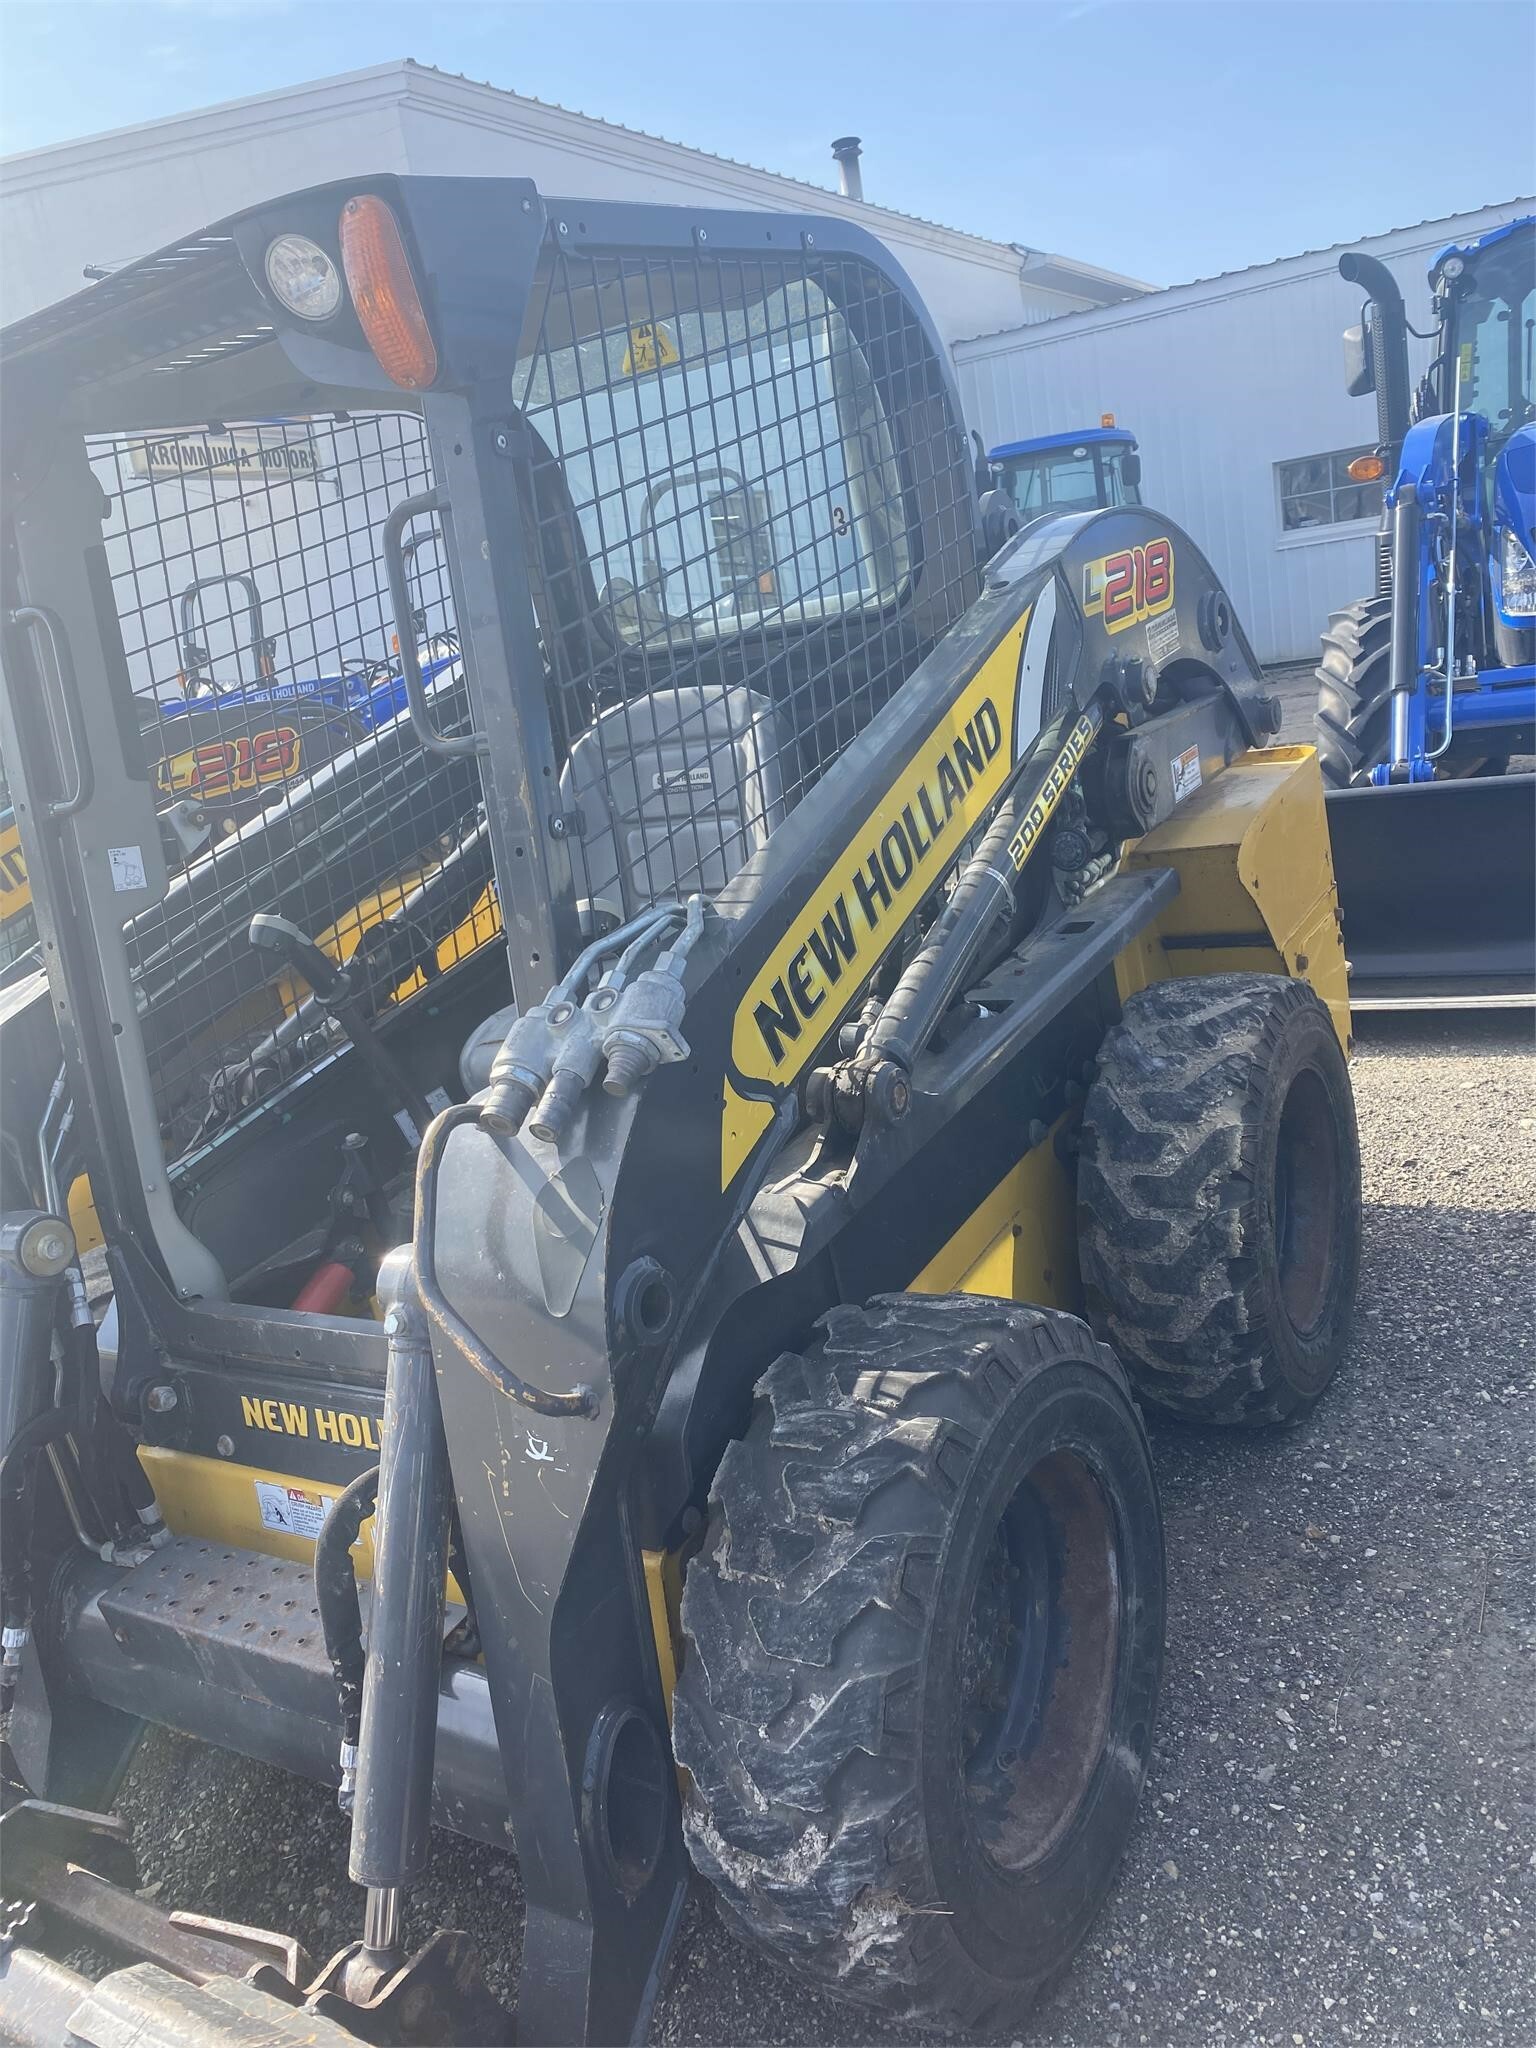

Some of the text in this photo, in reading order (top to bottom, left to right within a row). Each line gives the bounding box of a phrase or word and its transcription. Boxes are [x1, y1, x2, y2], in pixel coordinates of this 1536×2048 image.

[150, 445, 318, 469] KROMMINGA MOTORS
[1083, 538, 1174, 631] L218
[276, 683, 315, 699] HOLLAND
[1009, 717, 1093, 865] 200 SERIES
[752, 697, 1002, 1066] NEW HOLLAND
[240, 1395, 309, 1438] NEW
